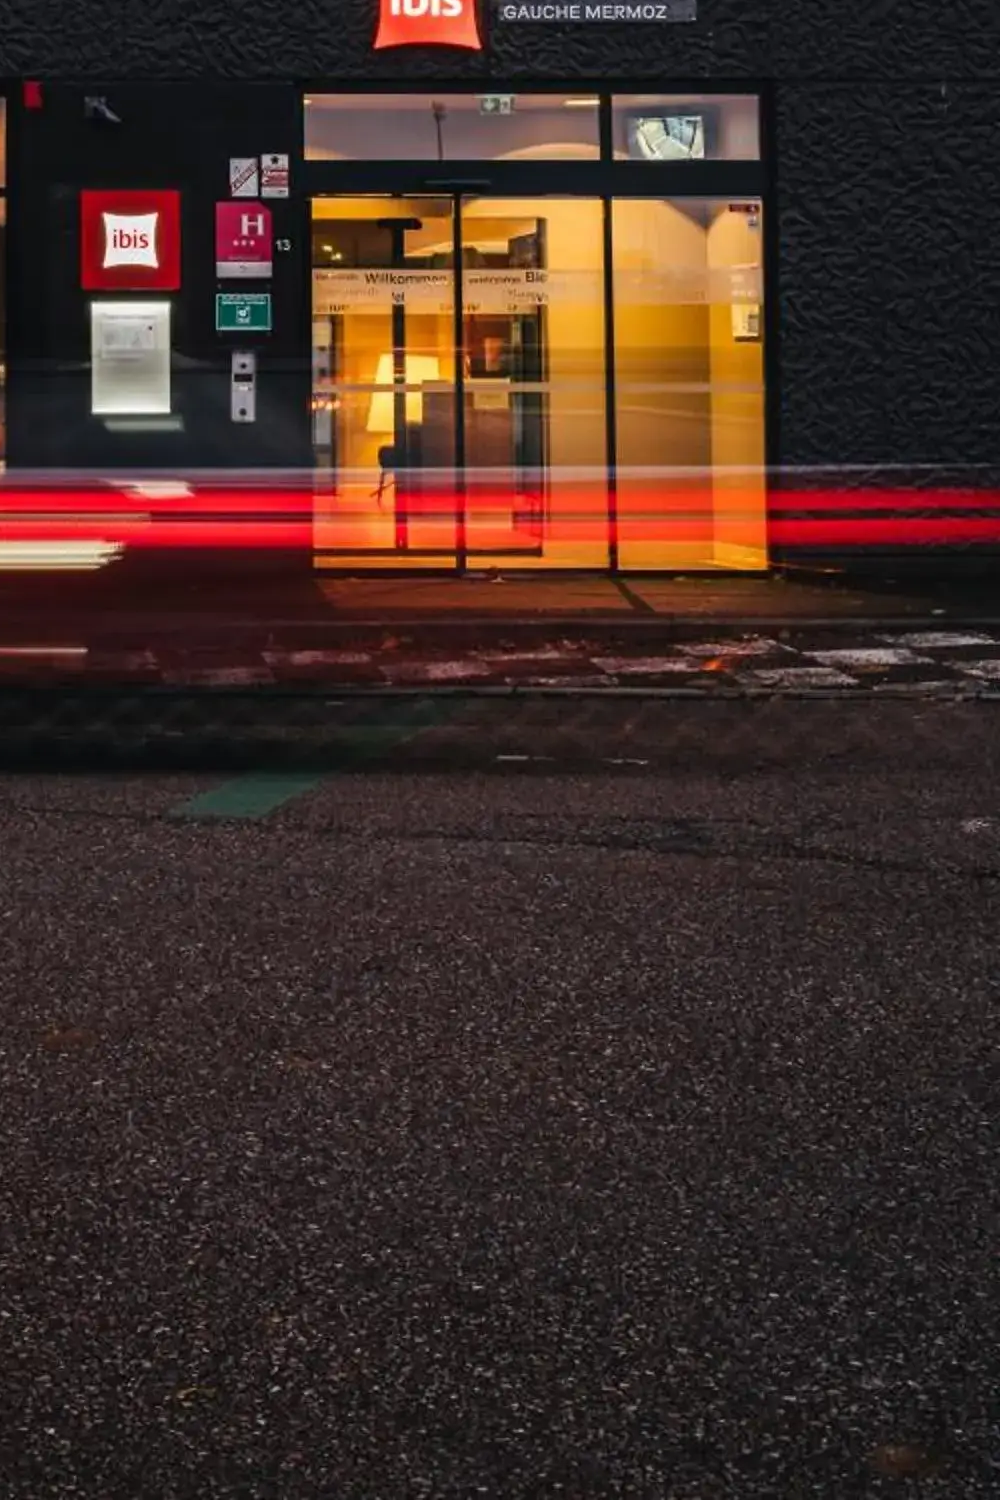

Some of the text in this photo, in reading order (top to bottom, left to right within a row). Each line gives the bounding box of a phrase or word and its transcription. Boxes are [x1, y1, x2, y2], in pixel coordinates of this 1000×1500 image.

[503, 5, 667, 20] GAUCHE MERMOZ
[241, 213, 264, 236] H
[113, 229, 149, 249] ibis
[276, 239, 292, 251] 13
